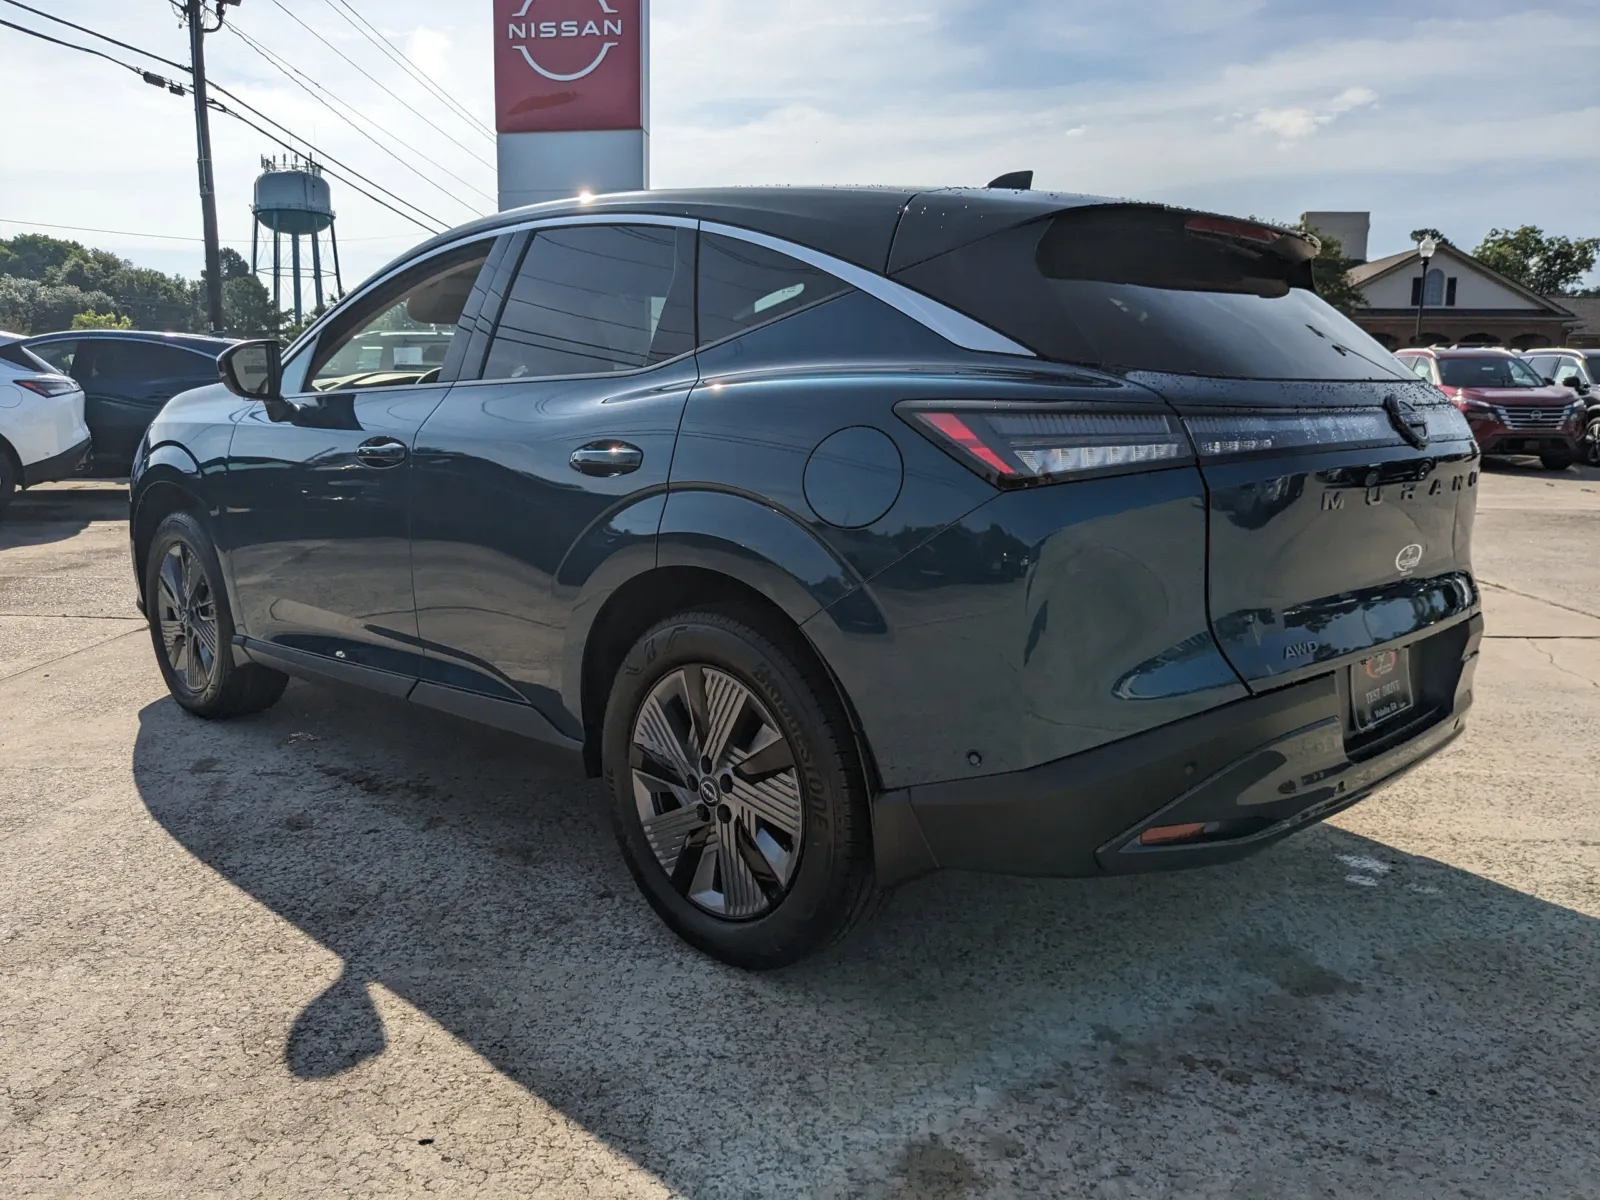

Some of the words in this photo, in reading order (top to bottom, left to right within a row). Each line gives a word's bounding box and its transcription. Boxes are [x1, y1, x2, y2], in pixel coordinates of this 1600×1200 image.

[508, 20, 622, 39] NISSAN
[1321, 471, 1477, 511] MURANO
[1284, 640, 1319, 660] AWD
[1365, 688, 1380, 704] TEST
